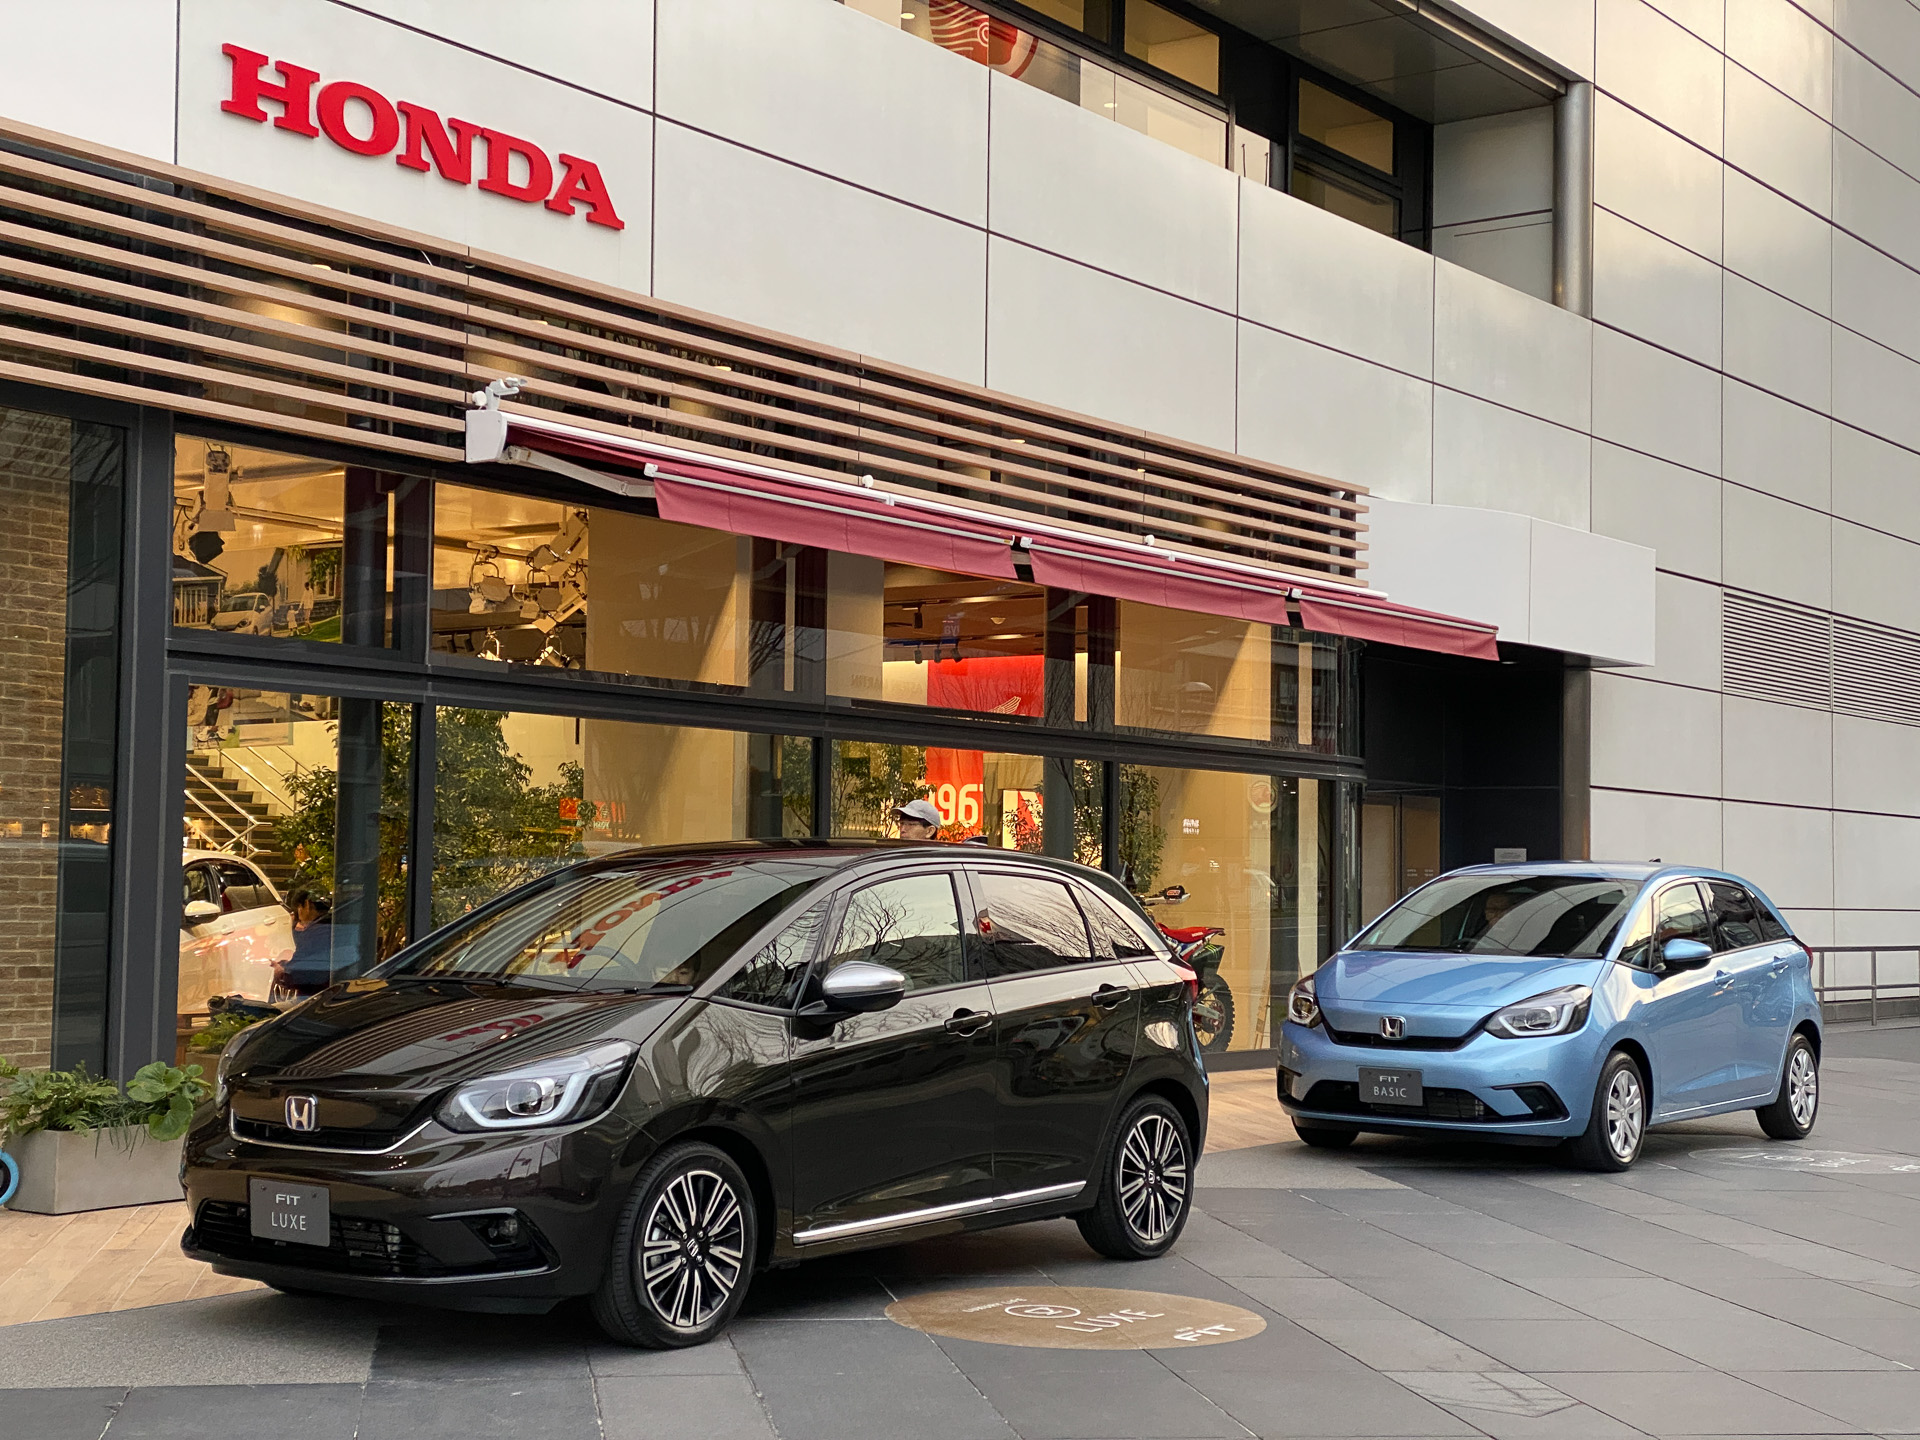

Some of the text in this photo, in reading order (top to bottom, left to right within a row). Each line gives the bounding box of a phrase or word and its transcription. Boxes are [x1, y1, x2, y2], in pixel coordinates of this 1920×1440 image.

[221, 42, 625, 230] HONDA
[1379, 1075, 1400, 1083] FIT
[1373, 1086, 1407, 1098] BASIC
[275, 1193, 301, 1206] FIT
[271, 1211, 307, 1231] LUXE
[1055, 1308, 1165, 1333] LUXE
[1173, 1324, 1236, 1342] FIT
